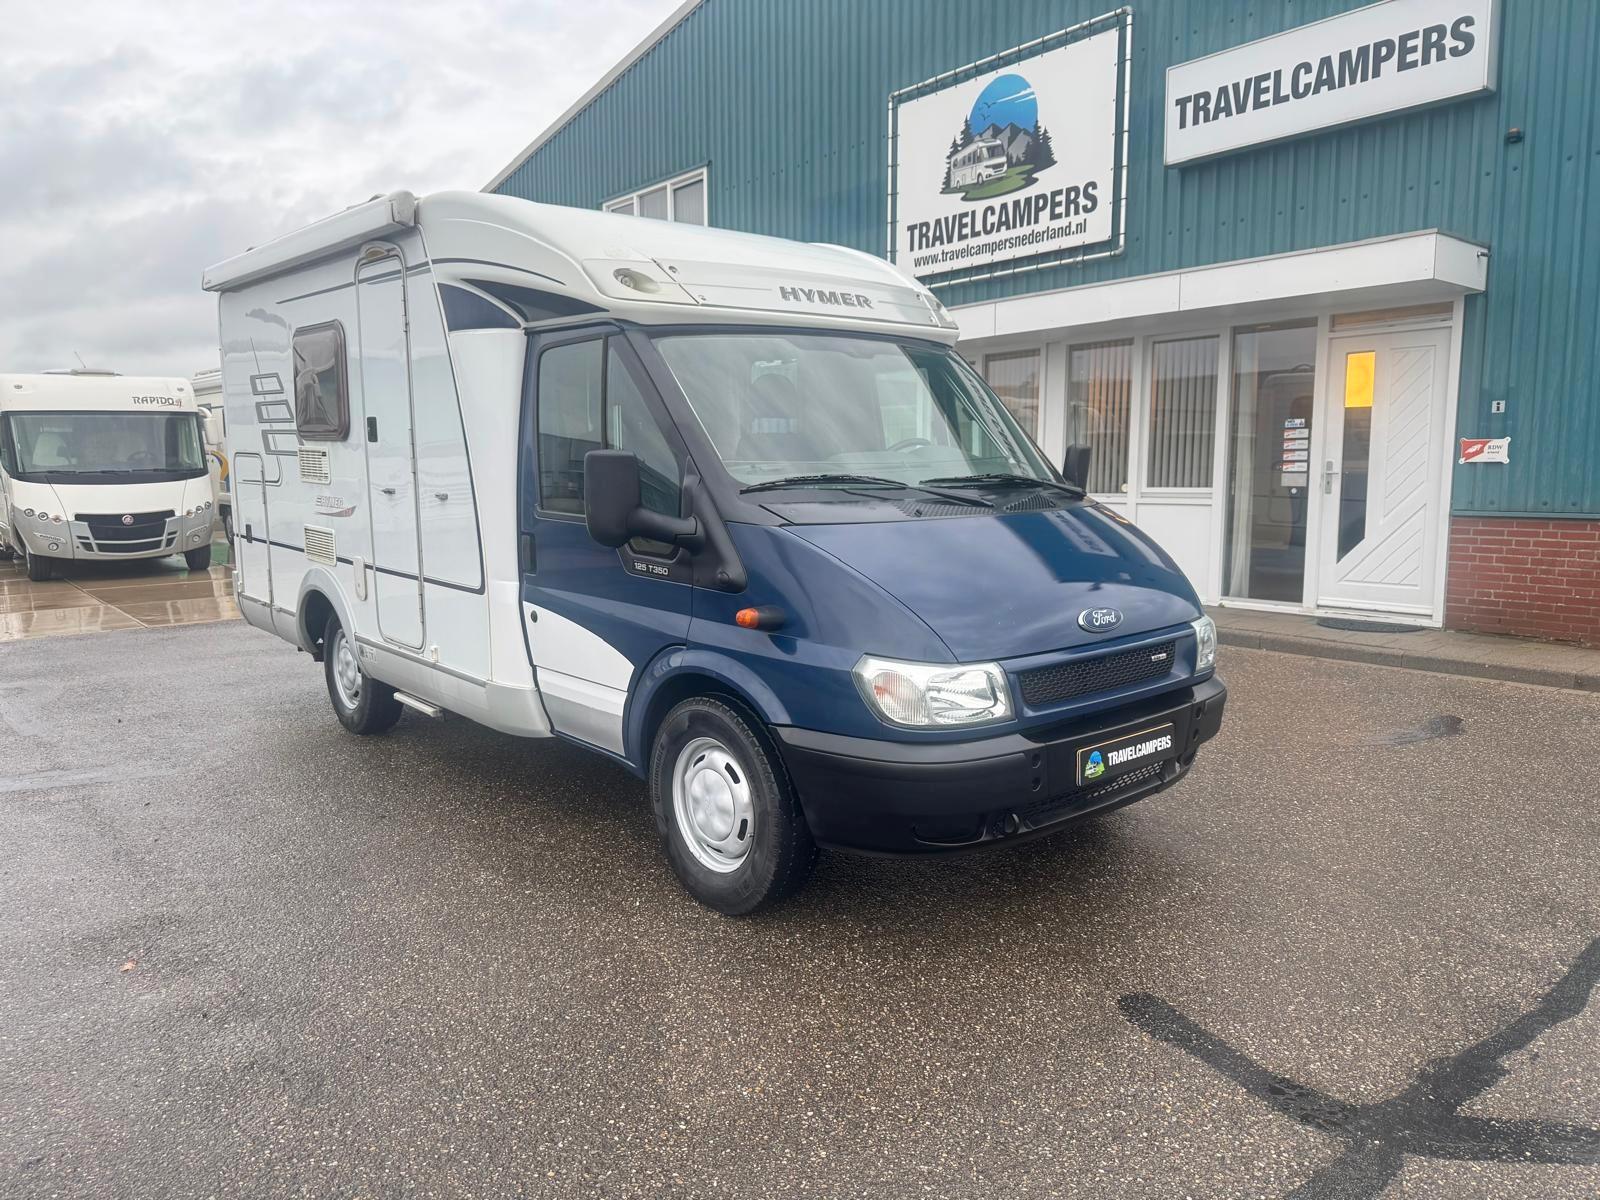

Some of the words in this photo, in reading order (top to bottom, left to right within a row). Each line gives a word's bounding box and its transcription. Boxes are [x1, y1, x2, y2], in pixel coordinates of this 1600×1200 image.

[1175, 15, 1476, 130] TRAVELCAMPERS
[907, 181, 1098, 252] TRAVELCAMPERS
[914, 218, 1087, 268] www.travelcampersnederland.nl
[779, 286, 874, 309] HYMER
[634, 562, 647, 571] 125
[648, 565, 669, 576] T350
[1092, 609, 1117, 626] Ford
[1107, 735, 1172, 767] TRAVELCAMPERS
